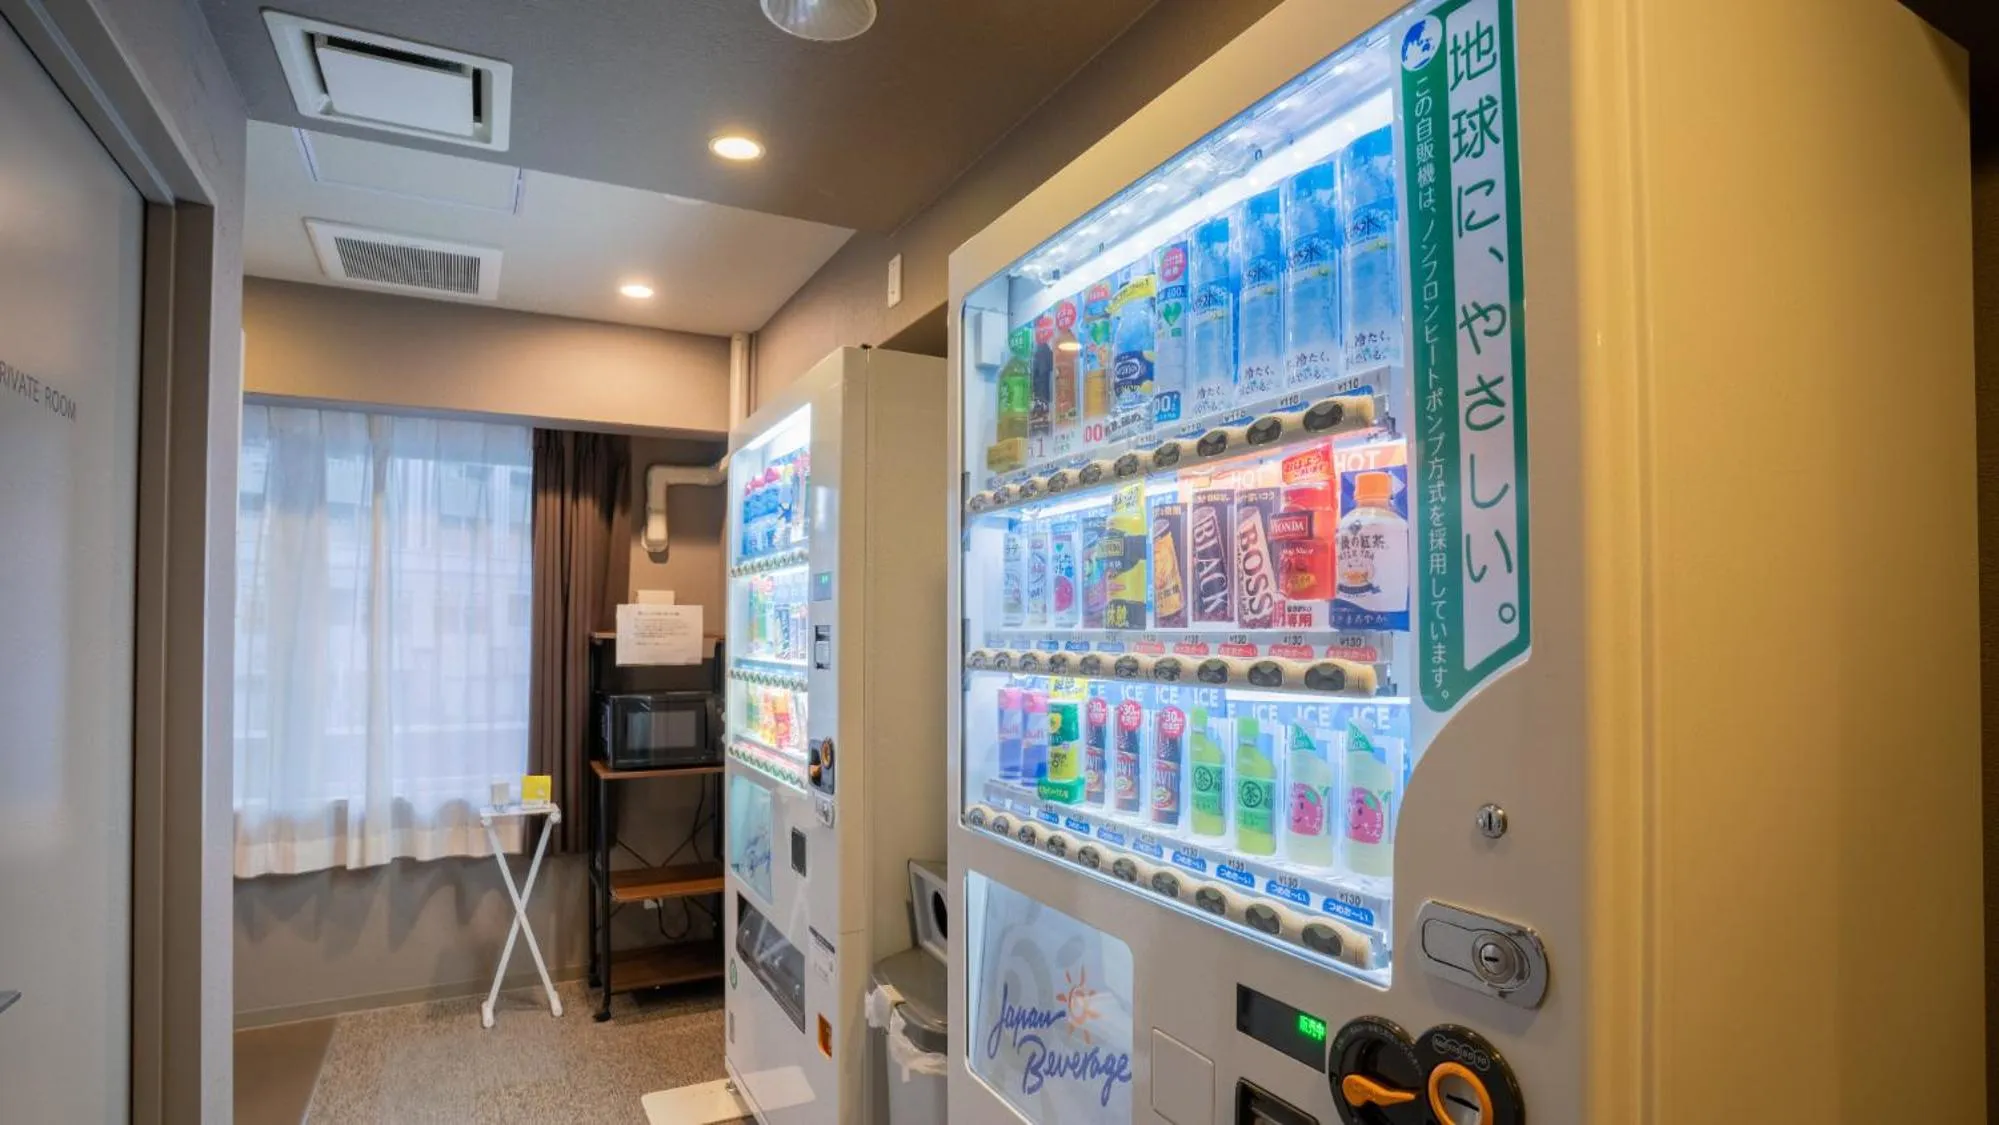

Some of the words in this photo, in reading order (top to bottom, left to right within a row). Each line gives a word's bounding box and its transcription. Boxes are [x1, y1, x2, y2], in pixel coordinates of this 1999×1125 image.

[1449, 20, 1517, 624] 地球に、やさしい。
[45, 386, 77, 422] ROOM
[1415, 76, 1449, 699] この自販機は、ノンフロンヒートポンプ方式を採用しています。
[1334, 449, 1382, 475] HOT
[1194, 515, 1228, 614] BLACK
[1239, 519, 1274, 615] BOSS
[1155, 686, 1179, 704] ICE
[1193, 688, 1219, 707] ICE
[1252, 703, 1279, 725] ICE
[1297, 705, 1331, 727] ICE
[1352, 706, 1391, 729] ICE
[987, 982, 1067, 1059] Japan
[1017, 1034, 1132, 1107] Beverage
